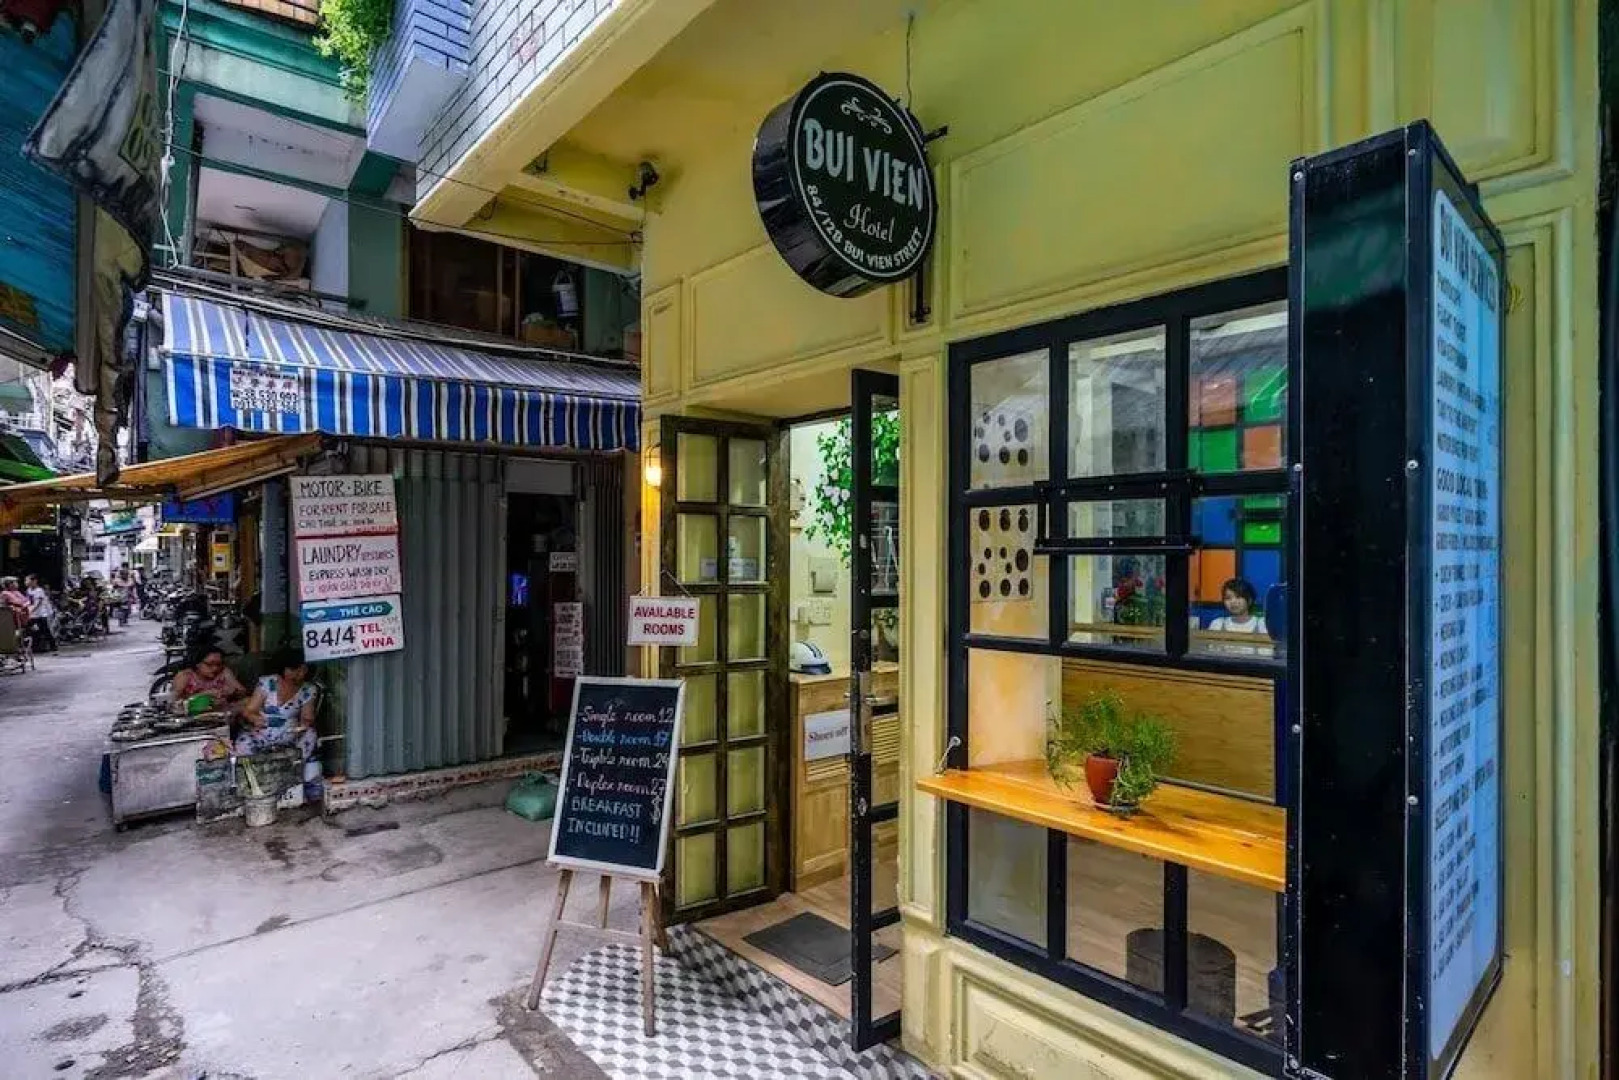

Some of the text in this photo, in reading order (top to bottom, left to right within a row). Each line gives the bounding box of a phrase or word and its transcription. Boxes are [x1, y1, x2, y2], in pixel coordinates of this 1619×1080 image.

[803, 117, 924, 212] BUI VIEN
[843, 203, 896, 244] Hotel
[844, 240, 865, 263] BUI
[866, 254, 893, 270] VIEN
[893, 225, 923, 267] STREET
[300, 480, 383, 498] MOTOR BIKE
[299, 501, 392, 516] FOR RENT FOR SALE
[302, 543, 362, 565] LAUNDRY
[634, 606, 695, 619] AVAILABLE
[305, 626, 356, 649] 84/4
[360, 623, 382, 634] TEL
[643, 624, 685, 636] ROOMS
[361, 637, 395, 648] VINA
[624, 712, 657, 722] room
[659, 707, 674, 723] 12
[620, 734, 651, 746] room
[618, 756, 651, 768] room
[617, 781, 650, 796] room
[571, 795, 642, 819] BREAKFAST
